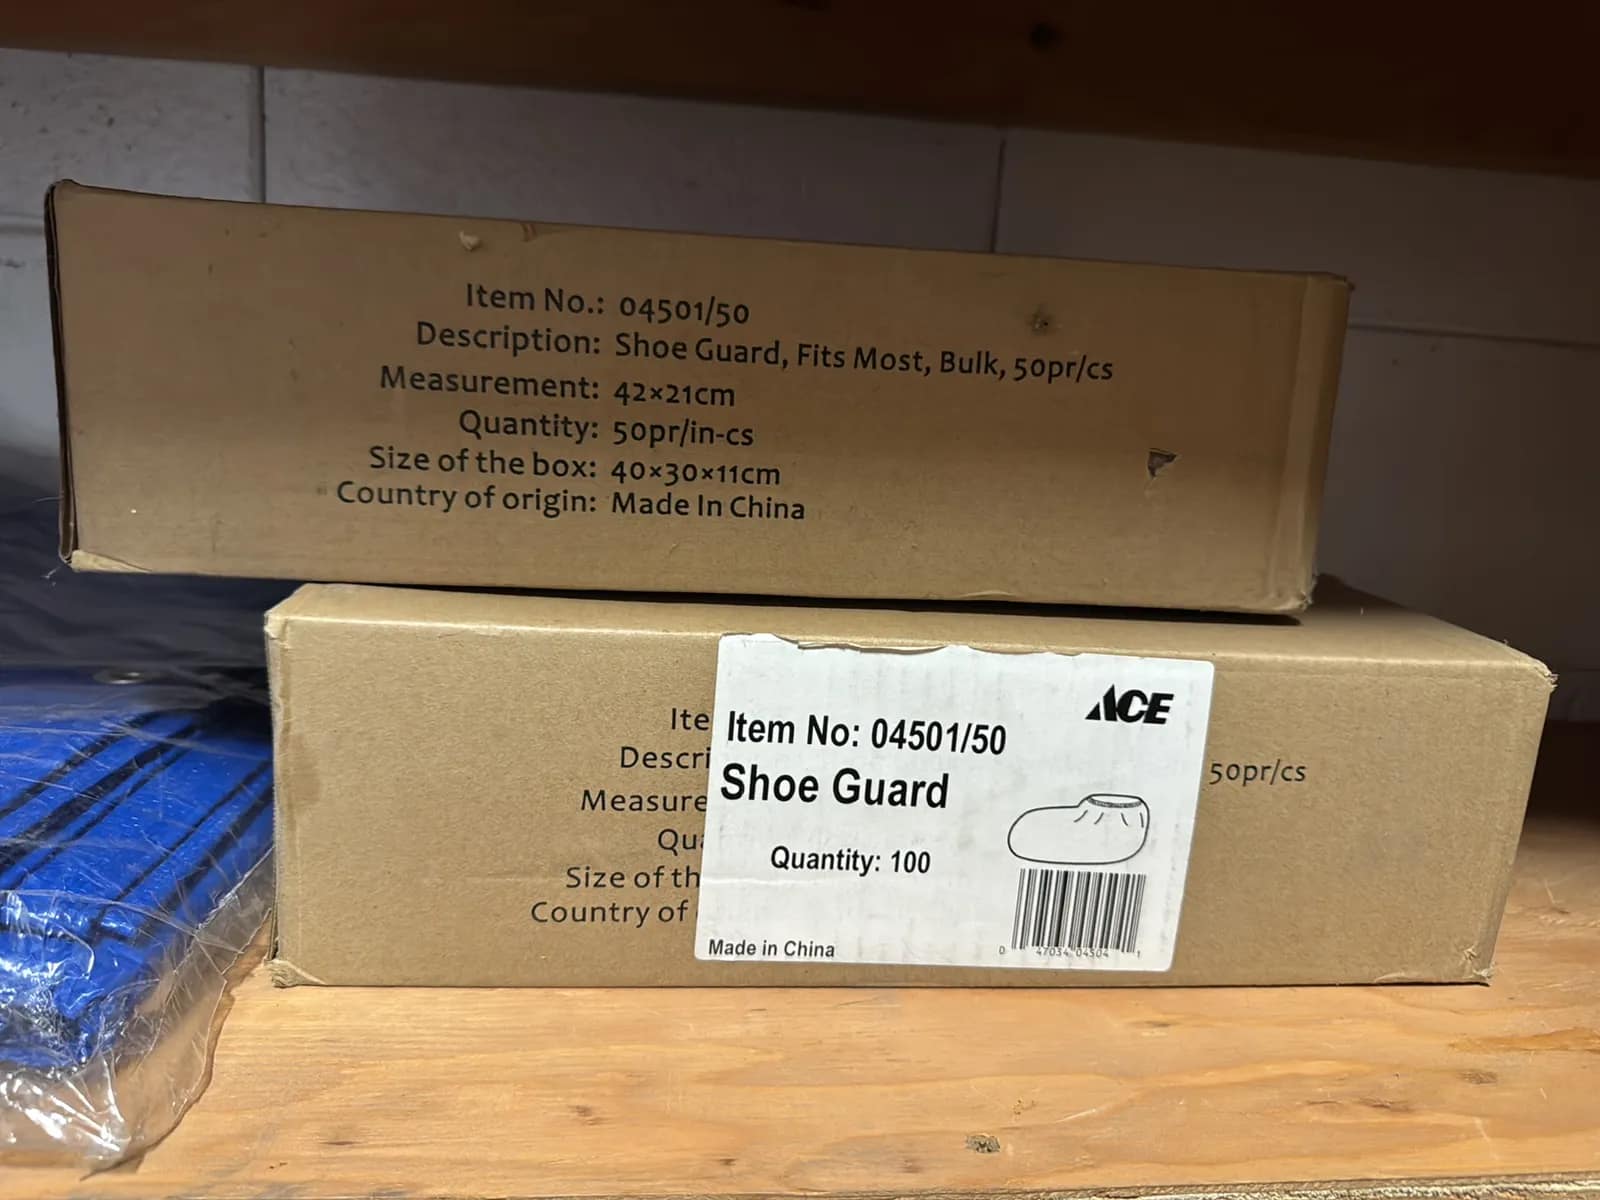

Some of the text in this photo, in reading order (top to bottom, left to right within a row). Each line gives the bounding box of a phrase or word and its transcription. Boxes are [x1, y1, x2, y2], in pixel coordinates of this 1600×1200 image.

[467, 283, 604, 315] Item No.:
[620, 296, 750, 326] 04501/50
[417, 321, 601, 357] Description:
[615, 332, 1113, 385] Shoe Guard, Fits Most, Bulk, 50pr/cs
[380, 365, 599, 400] Measurement:
[459, 409, 599, 445] Quantity:
[613, 418, 754, 448] 50pr/in-cs
[369, 446, 597, 478] Size of the box:
[337, 481, 597, 519] Country of origin:
[612, 491, 806, 520] Made In China
[671, 707, 710, 732] Ite
[1084, 684, 1176, 725] ACE
[727, 710, 1007, 756] Item No: 04501/50
[620, 746, 711, 769] Descri
[1209, 759, 1307, 788] 50pr/cs
[580, 790, 708, 813] Measure
[720, 763, 950, 809] Shoe Guard
[566, 865, 700, 889] Size of th
[770, 845, 931, 878] Quantity: 100
[531, 901, 650, 928] Country
[658, 899, 689, 923] of
[708, 938, 836, 958] Made in China
